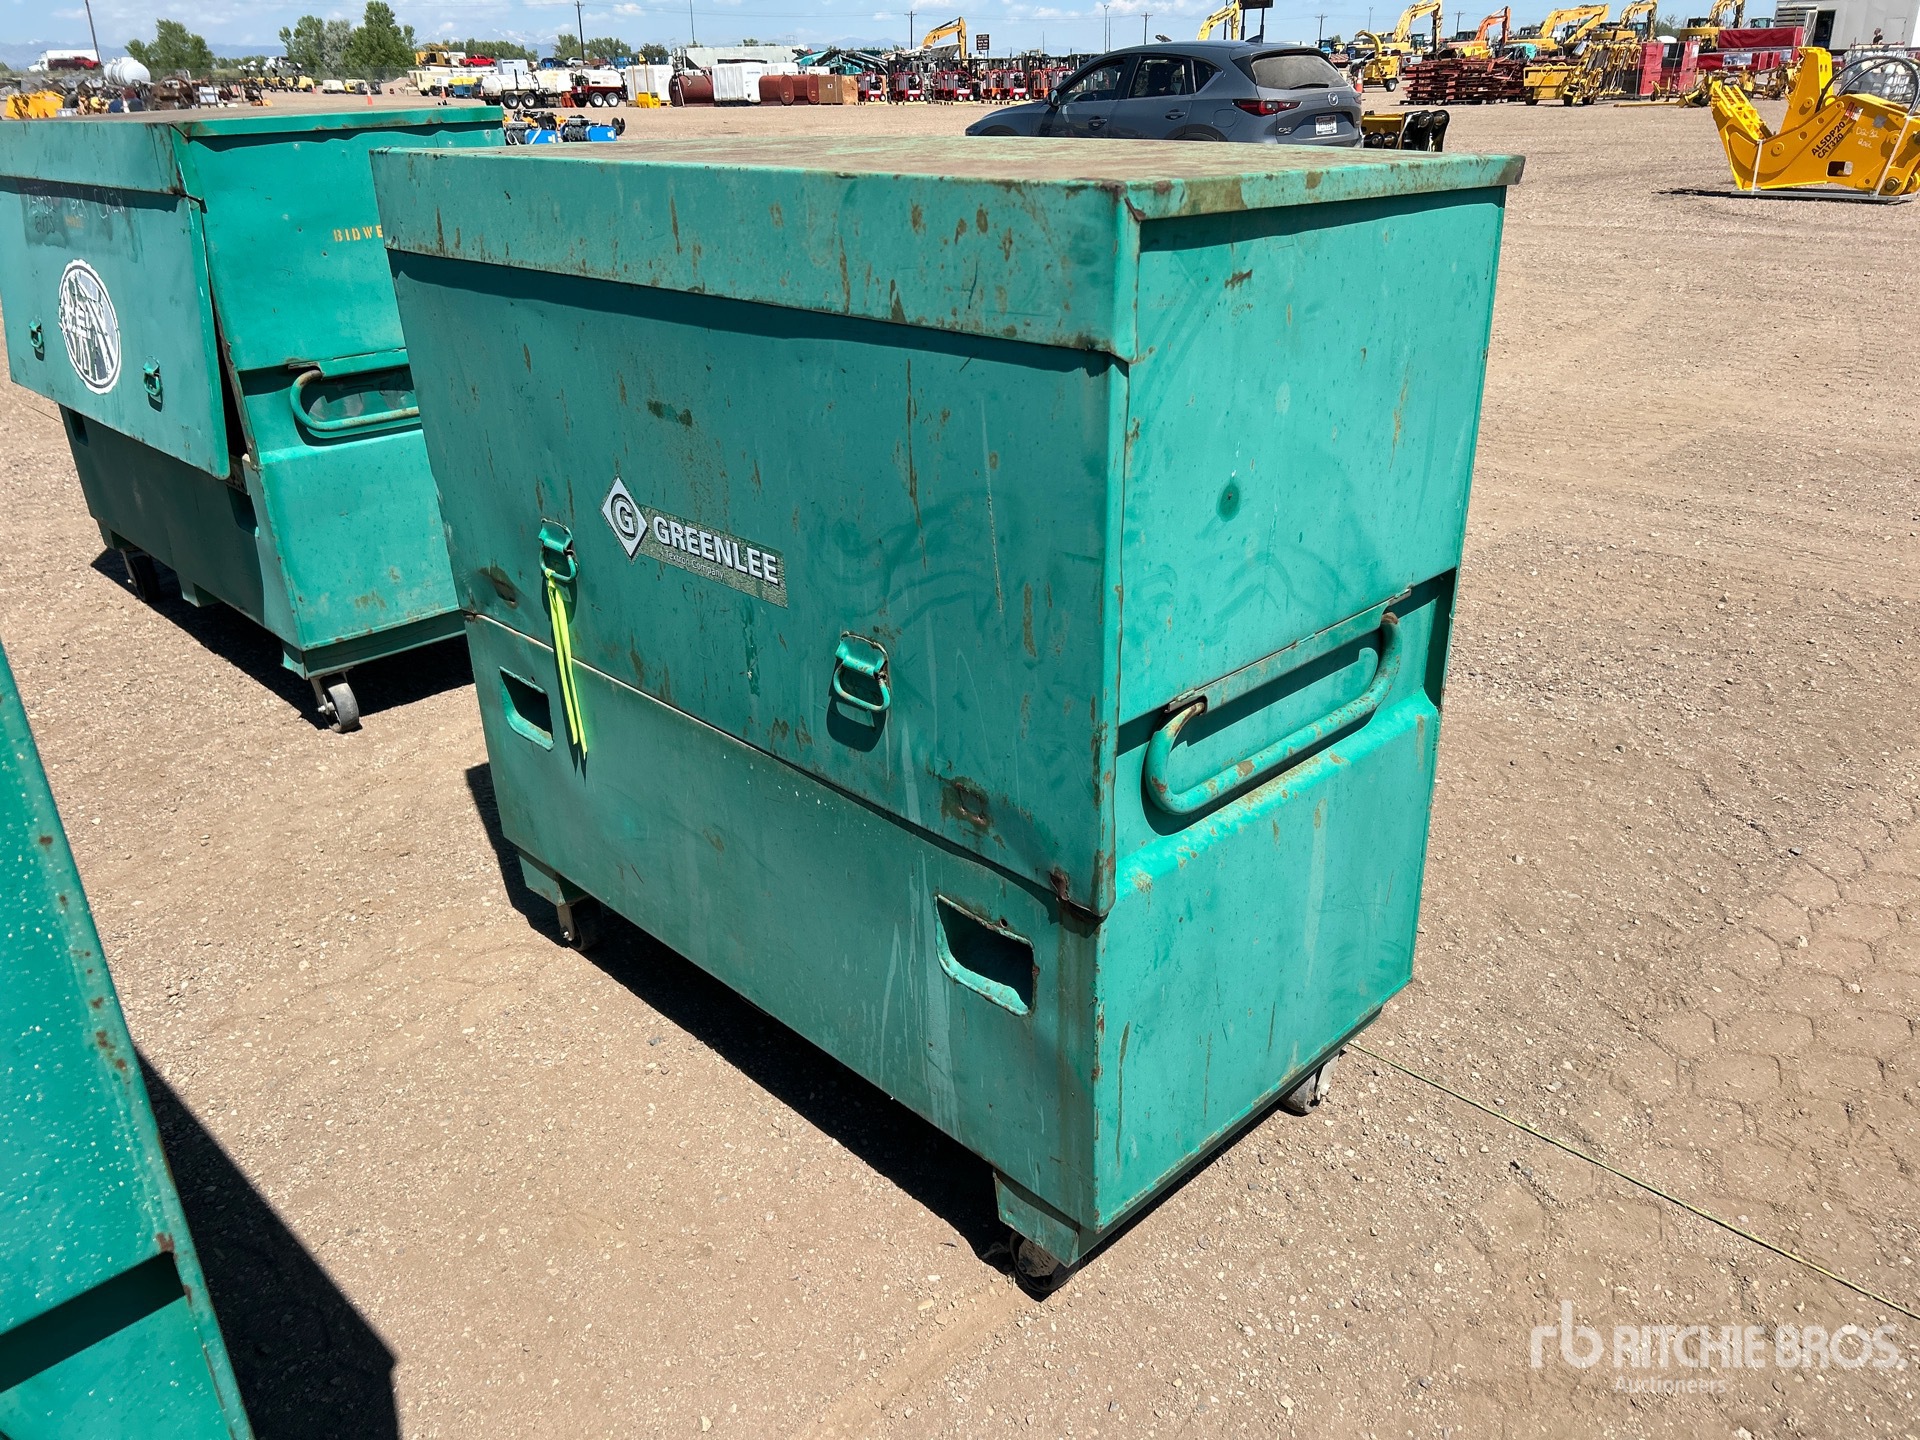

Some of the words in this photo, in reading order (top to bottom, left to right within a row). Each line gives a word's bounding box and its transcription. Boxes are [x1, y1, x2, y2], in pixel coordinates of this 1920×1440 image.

[1811, 121, 1846, 156] ALSDP20
[1817, 133, 1844, 159] CAT320
[653, 516, 779, 585] GREENLEE
[691, 560, 725, 580] Company
